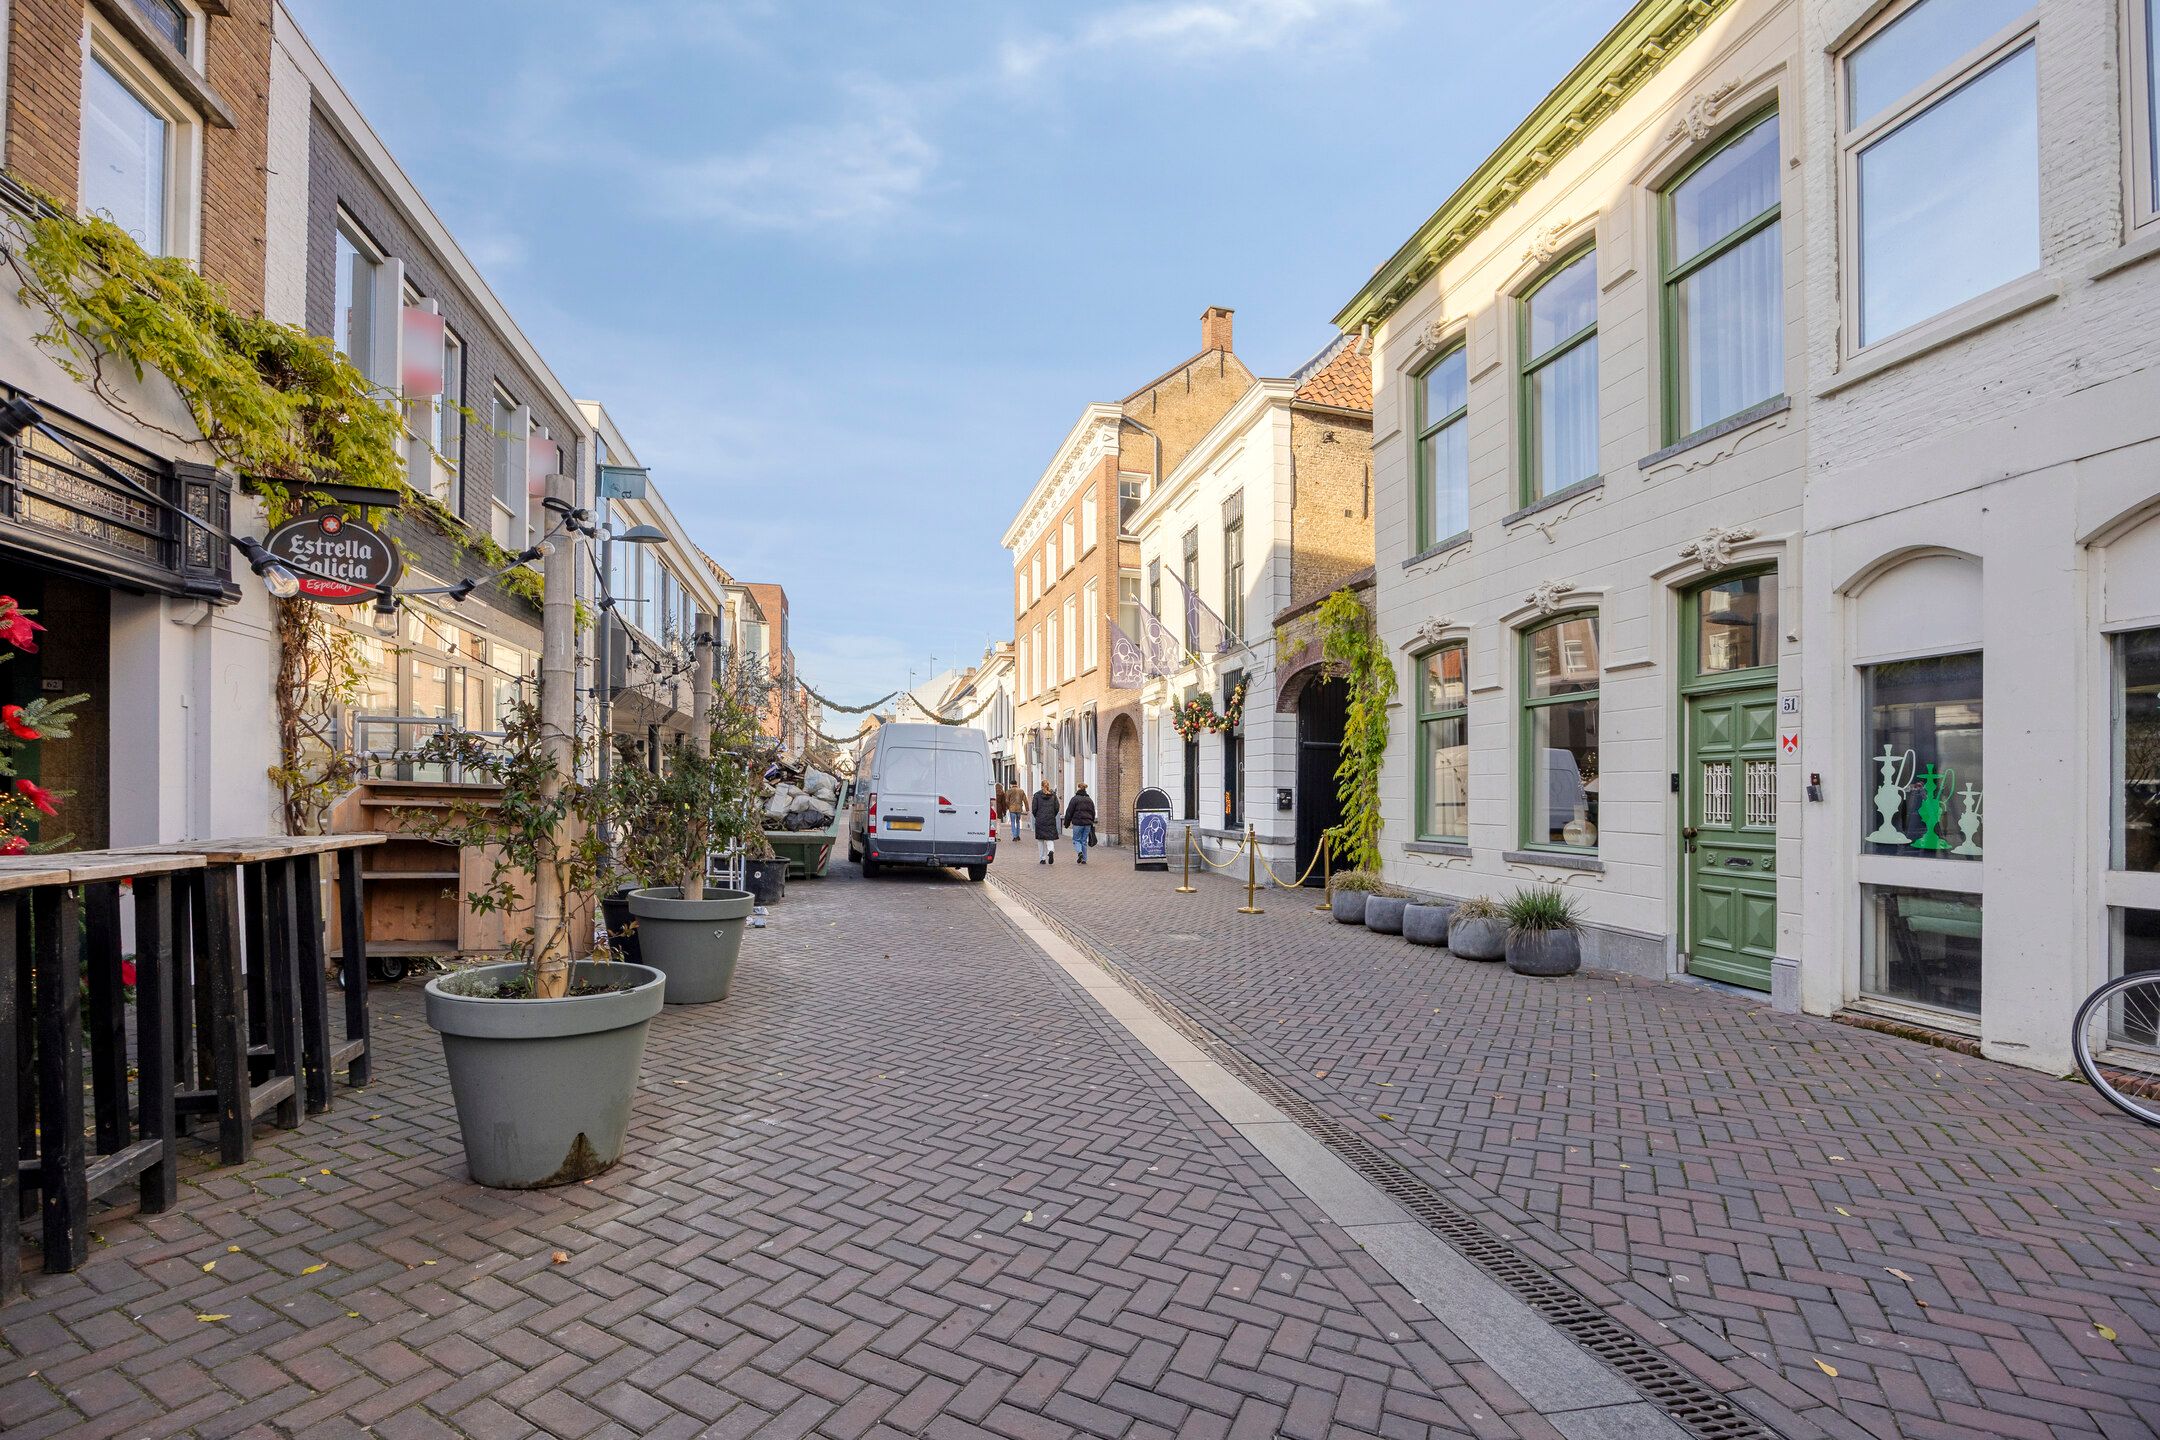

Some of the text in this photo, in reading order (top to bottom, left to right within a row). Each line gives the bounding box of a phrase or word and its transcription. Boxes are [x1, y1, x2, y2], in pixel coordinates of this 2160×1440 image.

[288, 534, 373, 560] Estrella
[292, 554, 368, 579] Galicia
[1784, 698, 1795, 711] 51
